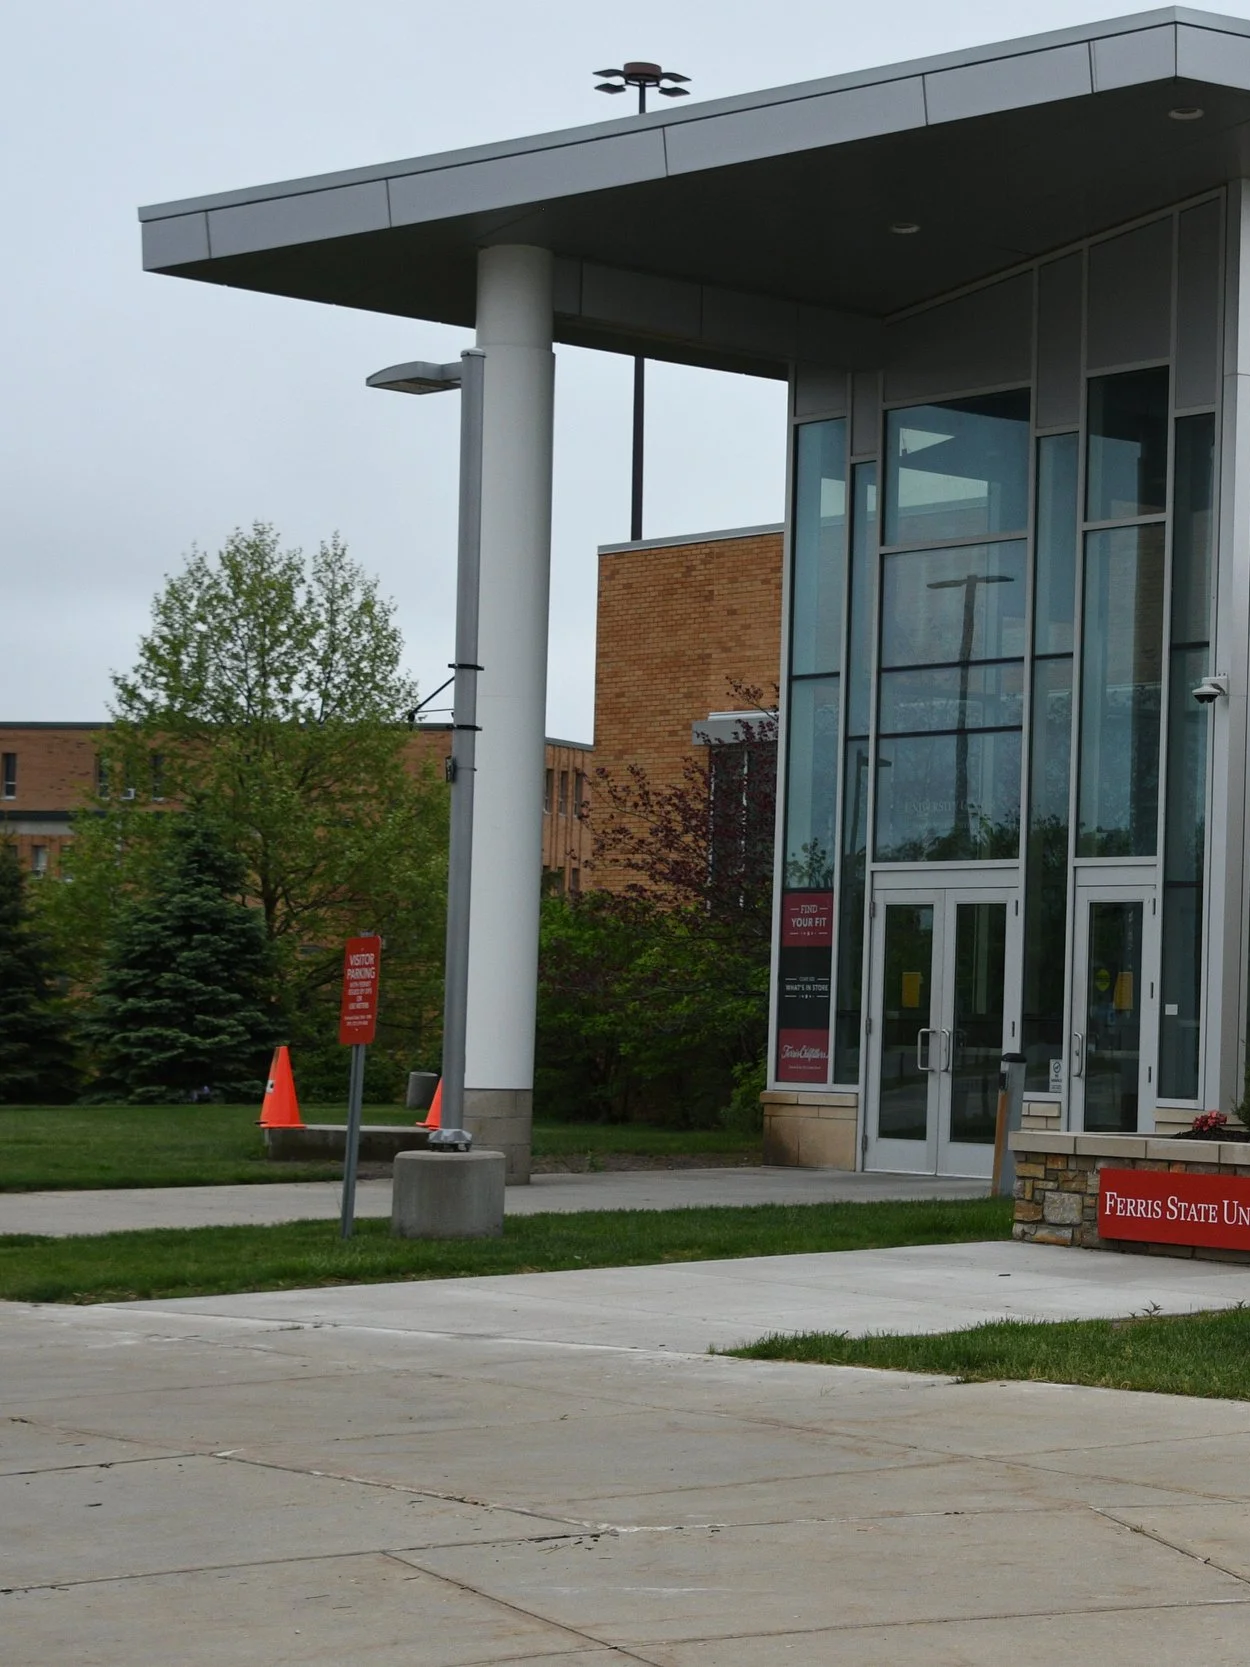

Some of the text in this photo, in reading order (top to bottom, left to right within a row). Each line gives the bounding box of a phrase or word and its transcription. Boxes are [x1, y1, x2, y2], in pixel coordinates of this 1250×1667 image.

[800, 904, 818, 914] FIND
[791, 917, 827, 928] YOUR FIT
[350, 953, 374, 966] VISITOR
[347, 968, 375, 979] PARKING
[1104, 1191, 1162, 1219] FERRIS
[1166, 1195, 1218, 1224] STATE
